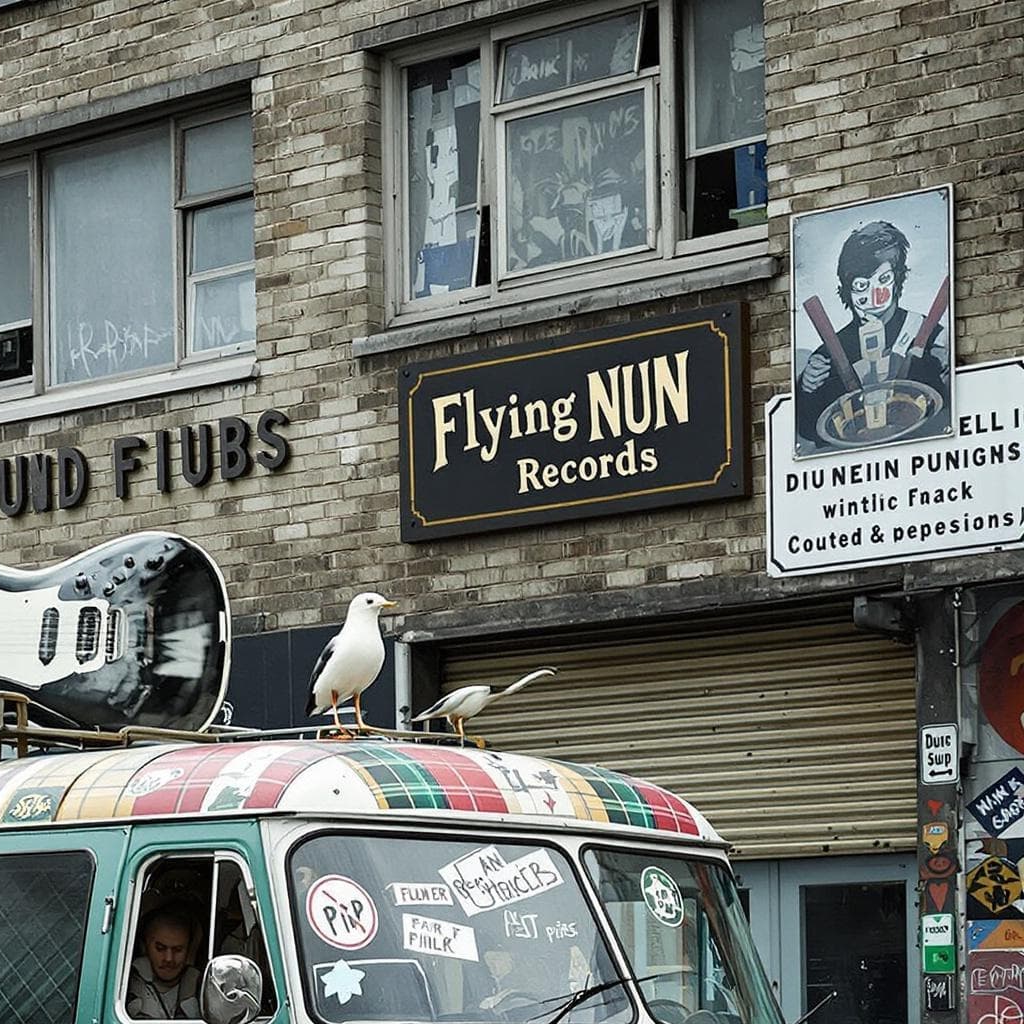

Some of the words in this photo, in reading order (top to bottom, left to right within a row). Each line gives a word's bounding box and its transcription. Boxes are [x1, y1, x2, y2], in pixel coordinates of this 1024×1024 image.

[431, 384, 578, 473] Flying
[586, 350, 691, 443] NUN
[517, 443, 658, 495] Records
[908, 480, 974, 508] Fnack
[788, 527, 862, 555] Couted
[870, 524, 885, 544] &
